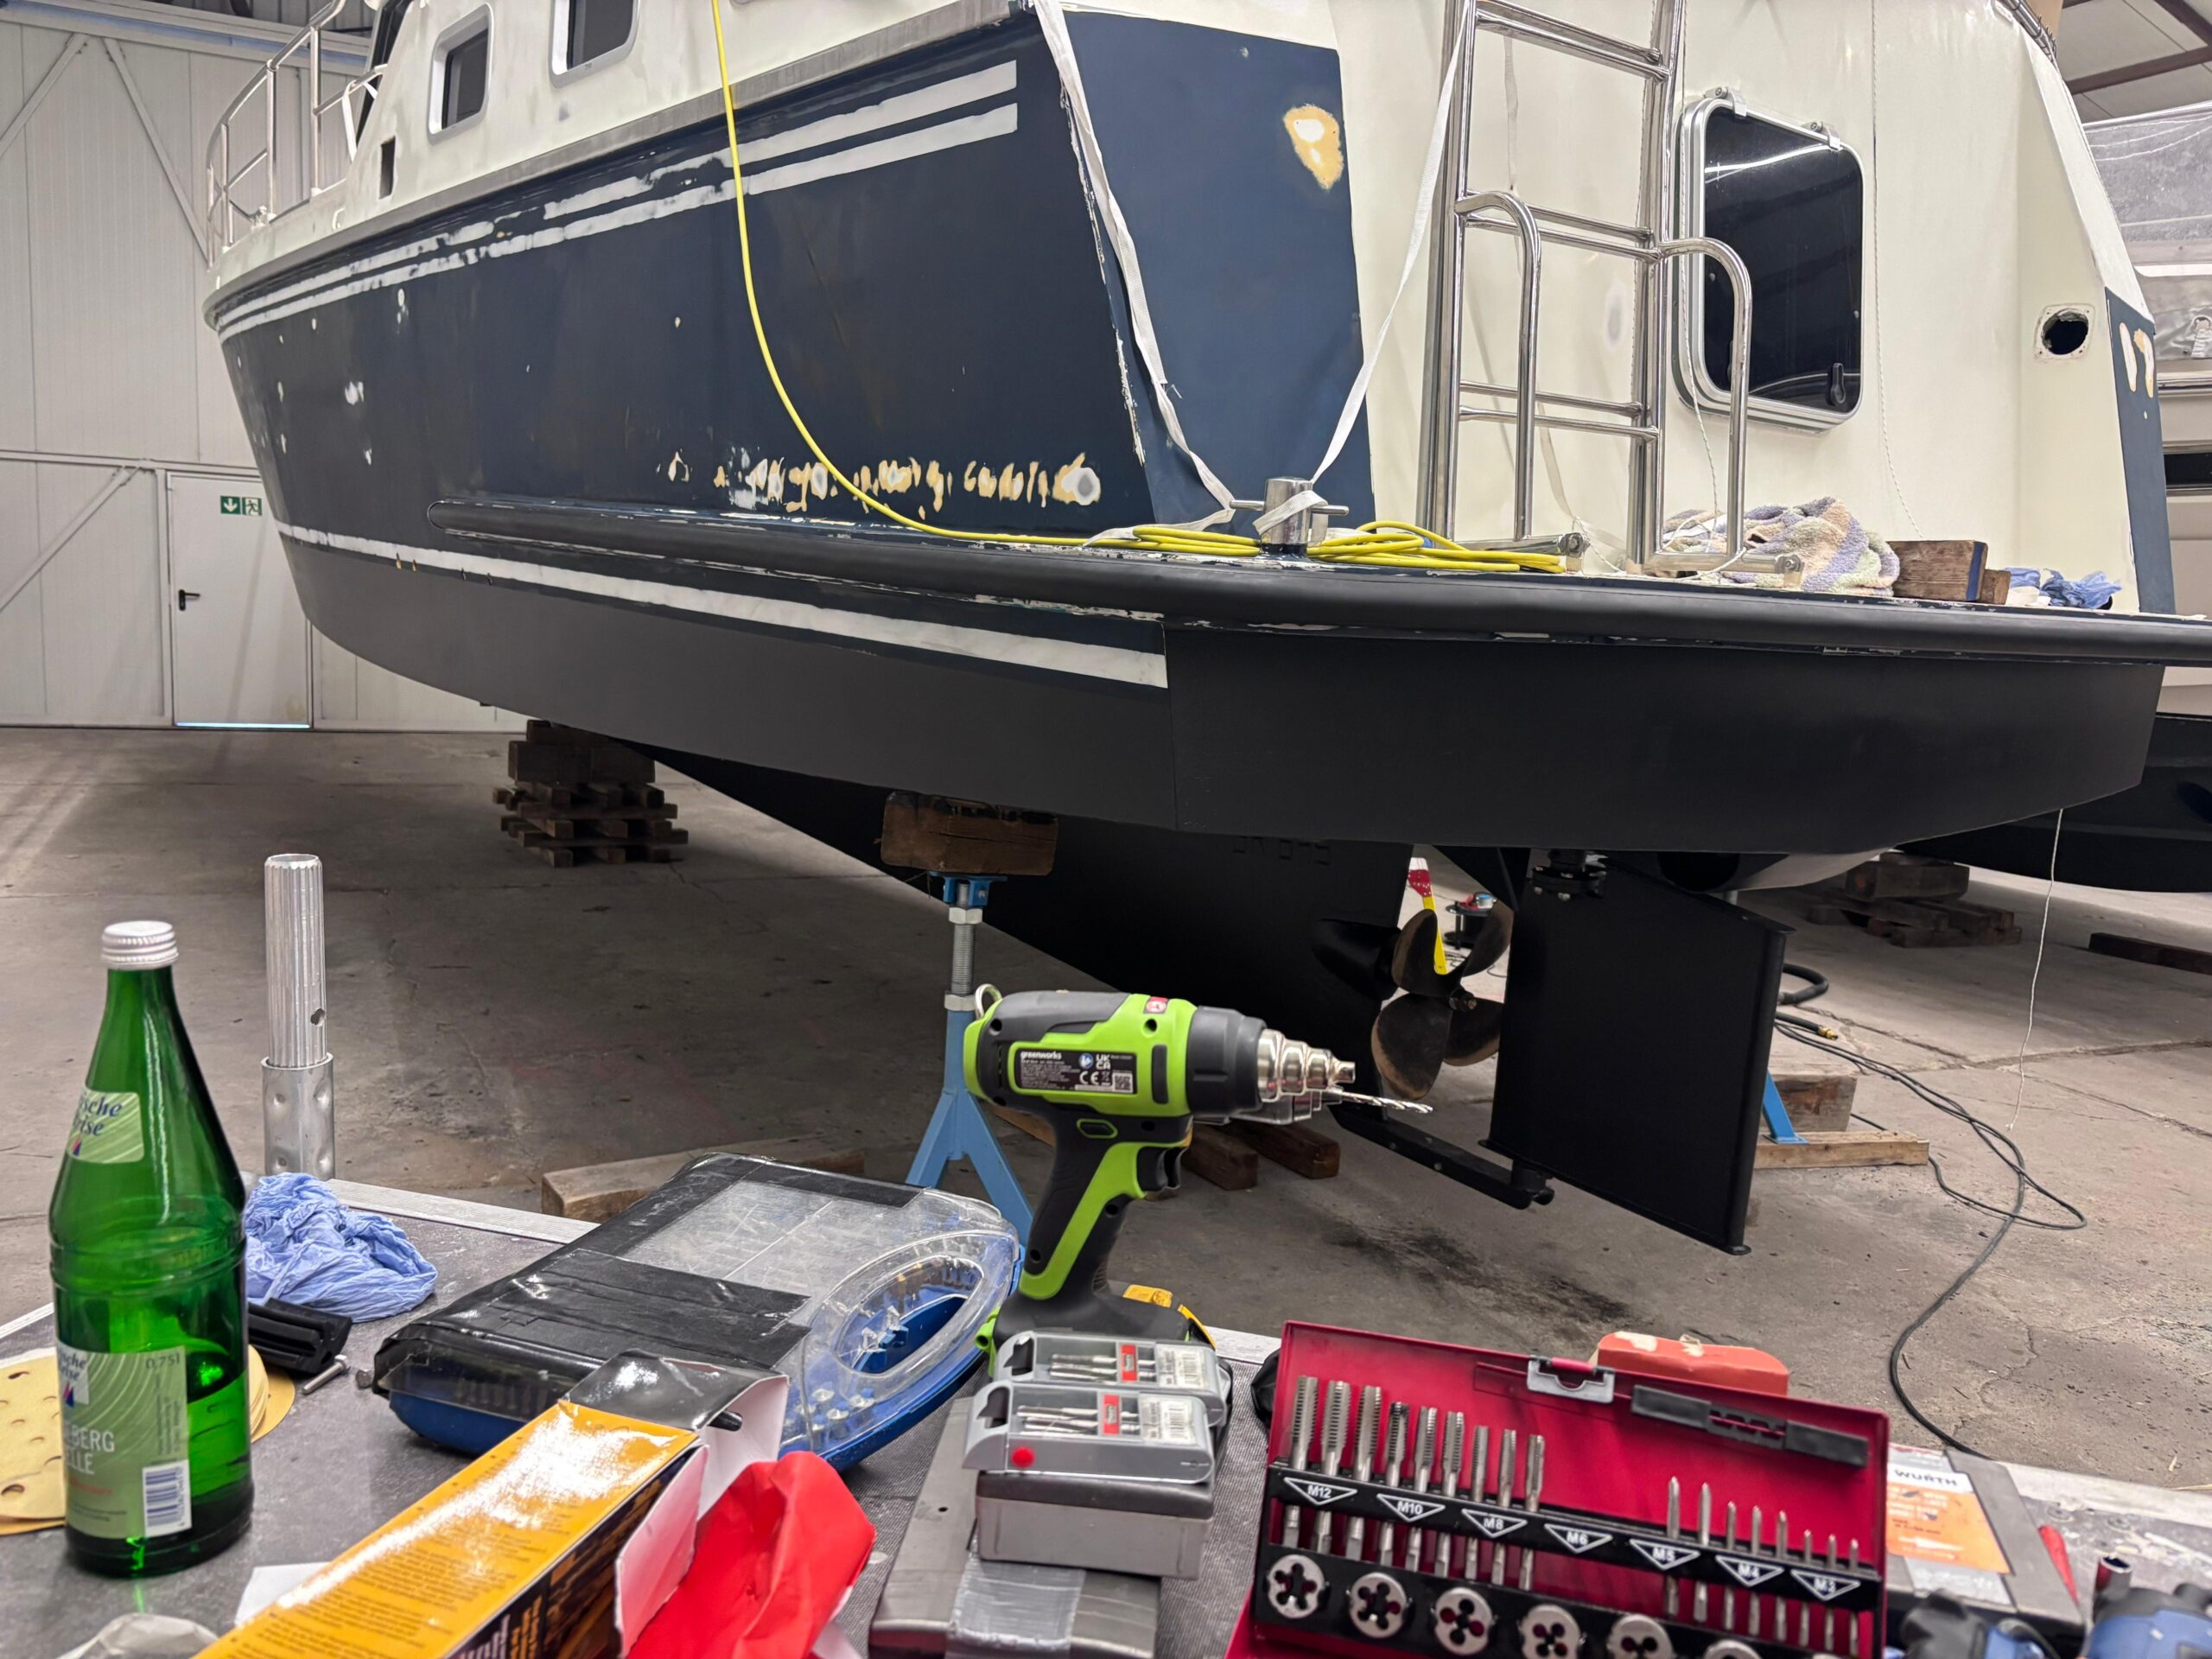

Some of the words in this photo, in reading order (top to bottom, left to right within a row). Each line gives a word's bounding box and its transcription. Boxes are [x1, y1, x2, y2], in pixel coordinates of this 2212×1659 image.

[1020, 1051, 1062, 1060] greenworks
[1306, 1484, 1332, 1499] M12
[1396, 1500, 1424, 1516] M10
[1482, 1517, 1503, 1531] M8
[1566, 1531, 1590, 1545] M6
[1652, 1548, 1675, 1562] M5
[1738, 1563, 1760, 1579] M4
[1814, 1577, 1836, 1593] M3
